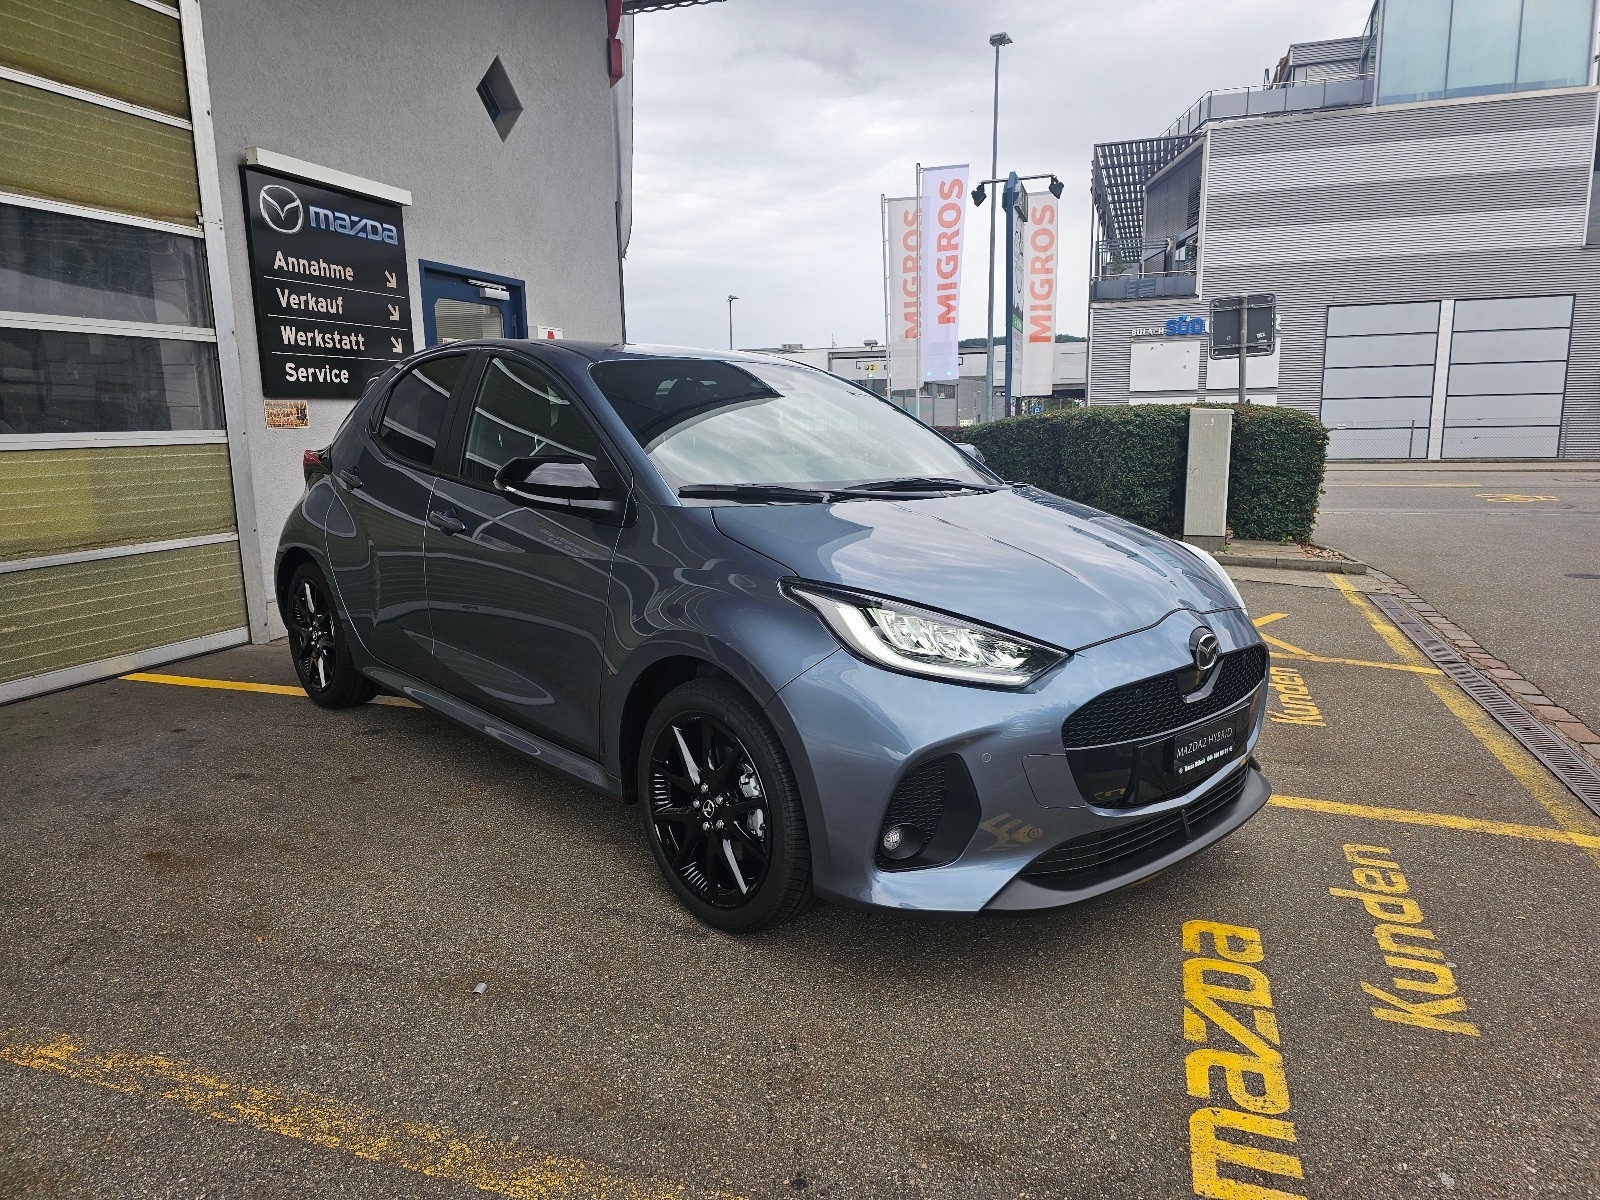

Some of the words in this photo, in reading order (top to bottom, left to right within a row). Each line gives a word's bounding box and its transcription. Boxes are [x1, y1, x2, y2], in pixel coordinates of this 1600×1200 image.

[273, 250, 354, 281] Annahme
[936, 178, 964, 325] MIGROS
[902, 208, 923, 339] MIGROS
[1029, 204, 1055, 343] MIGROS
[276, 287, 343, 314] Verkauf
[280, 325, 365, 350] Werkstatt
[1165, 312, 1204, 336] SÜD
[285, 362, 349, 384] Service
[1267, 666, 1327, 727] Kunden
[1176, 737, 1207, 759] MAZDA2
[1208, 727, 1233, 745] HYBRID
[1329, 843, 1481, 1037] Kunden
